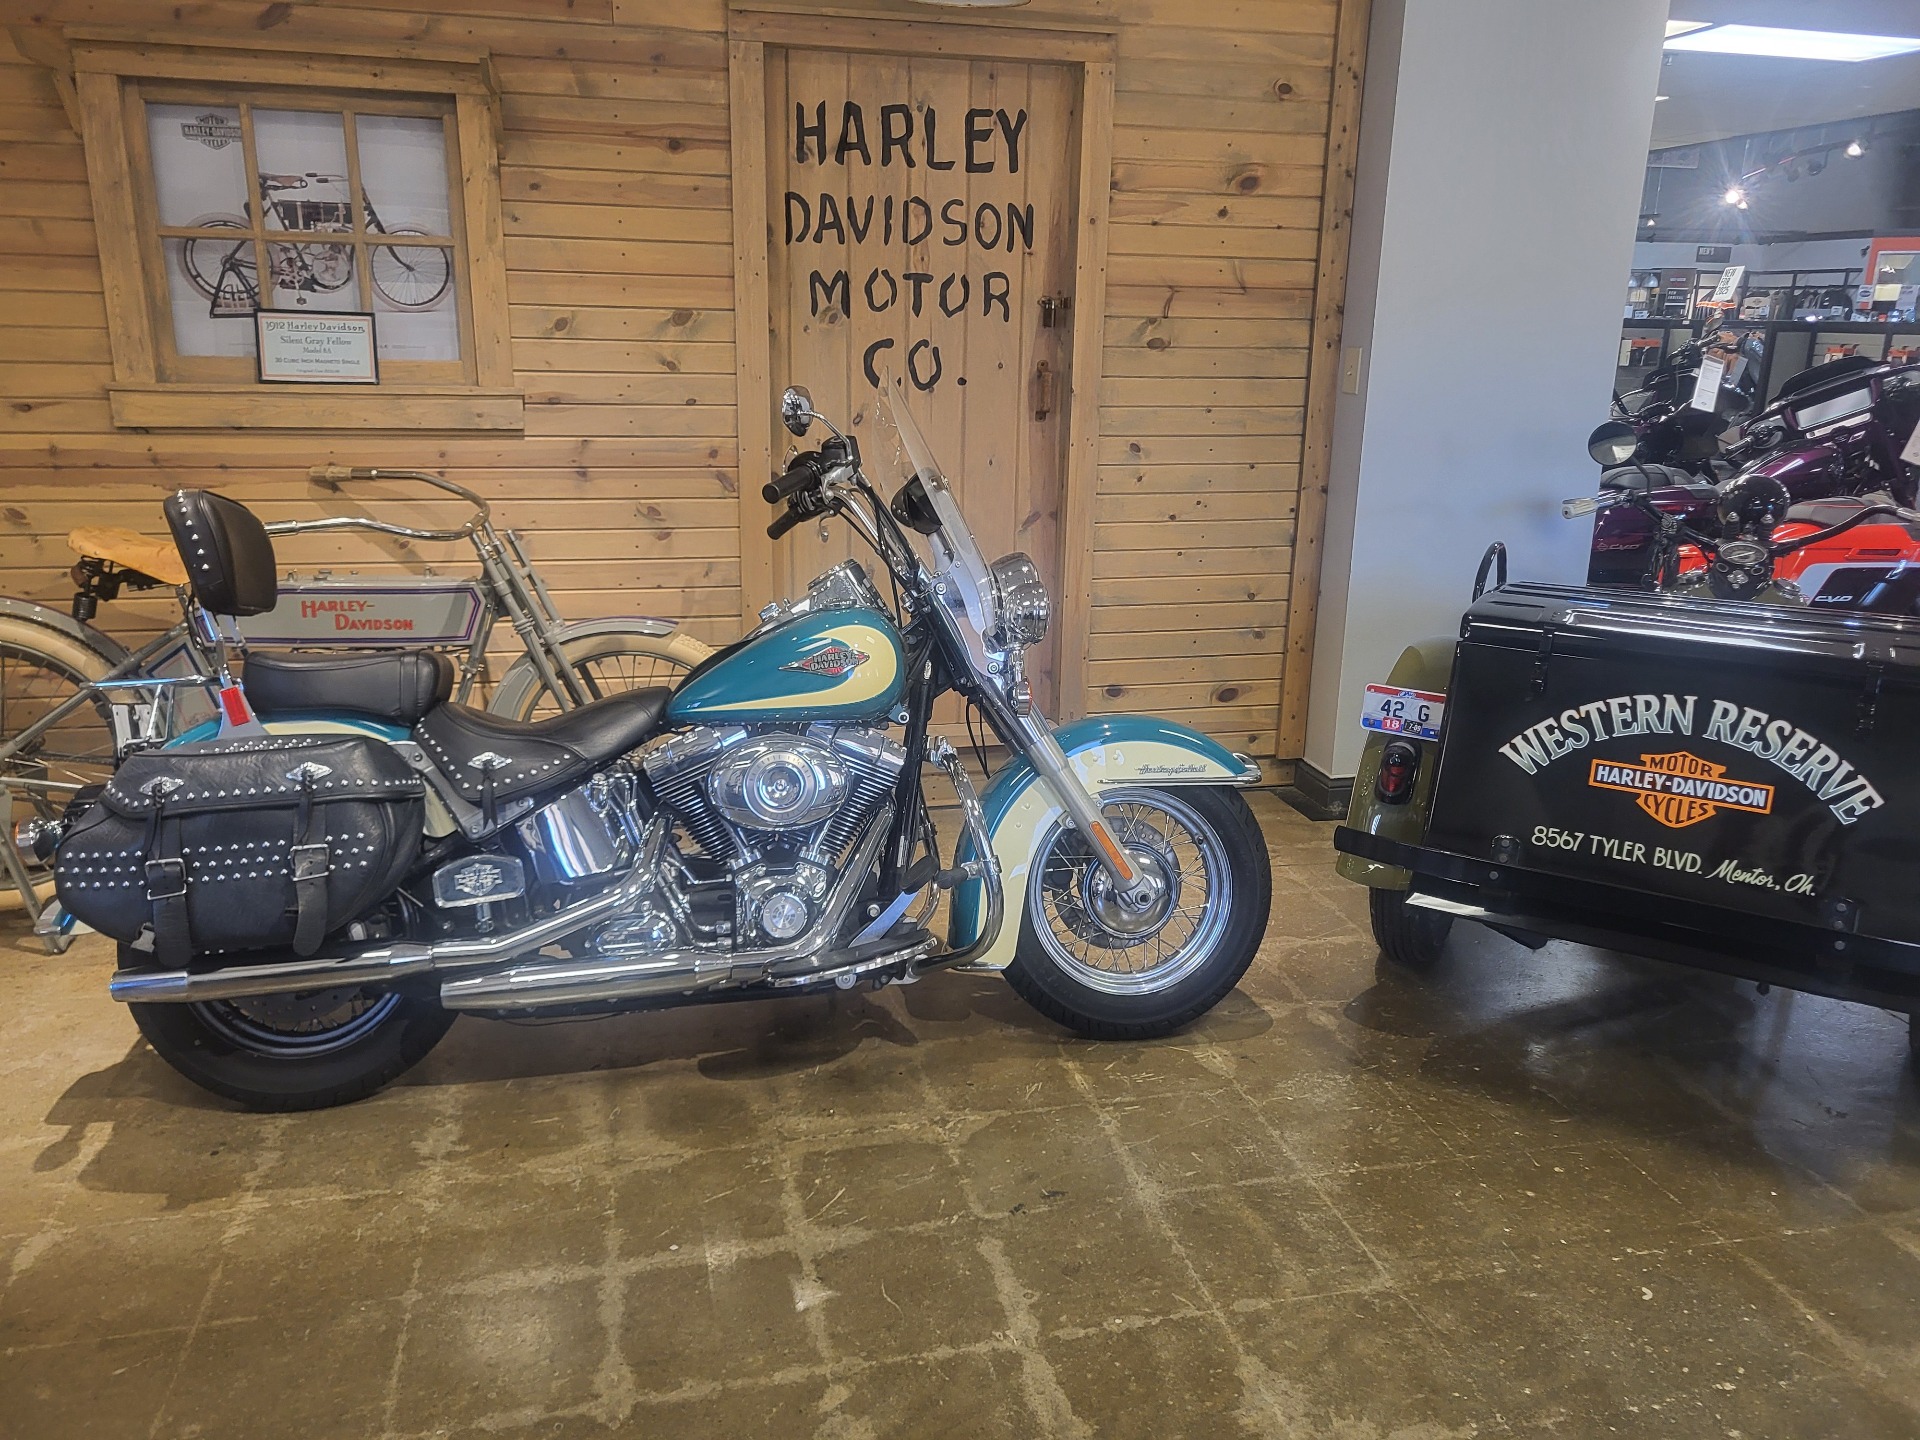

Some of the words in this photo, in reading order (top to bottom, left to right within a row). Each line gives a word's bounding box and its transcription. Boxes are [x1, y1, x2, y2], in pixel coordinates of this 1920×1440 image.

[796, 100, 1027, 173] HARLEY
[785, 192, 1034, 253] DAVIDSON
[1719, 277, 1731, 286] FOR
[1723, 268, 1737, 277] NEW
[810, 267, 1010, 323] MOTOR
[265, 321, 285, 331] 1912
[280, 335, 303, 344] Silent
[305, 336, 324, 347] Gray
[326, 337, 352, 345] Fellow
[864, 337, 967, 391] CO.
[1815, 595, 1853, 603] CVO
[335, 613, 413, 631] DAVIDSON
[810, 659, 861, 672] DAVIDSON
[1380, 699, 1405, 718] 42
[1418, 704, 1431, 722] G
[1498, 694, 1698, 775] WESTERN
[1702, 699, 1885, 825] RESERVE
[1649, 753, 1713, 777] MOTOR
[1596, 765, 1767, 807] HARLEY-DAVIDSON
[1643, 793, 1709, 824] CYCLES
[1531, 825, 1585, 852] 8567
[1589, 834, 1647, 864] TYLER
[1653, 847, 1702, 875] BLVD.
[1704, 859, 1780, 890] Mentor,
[1784, 873, 1816, 896] Oh.
